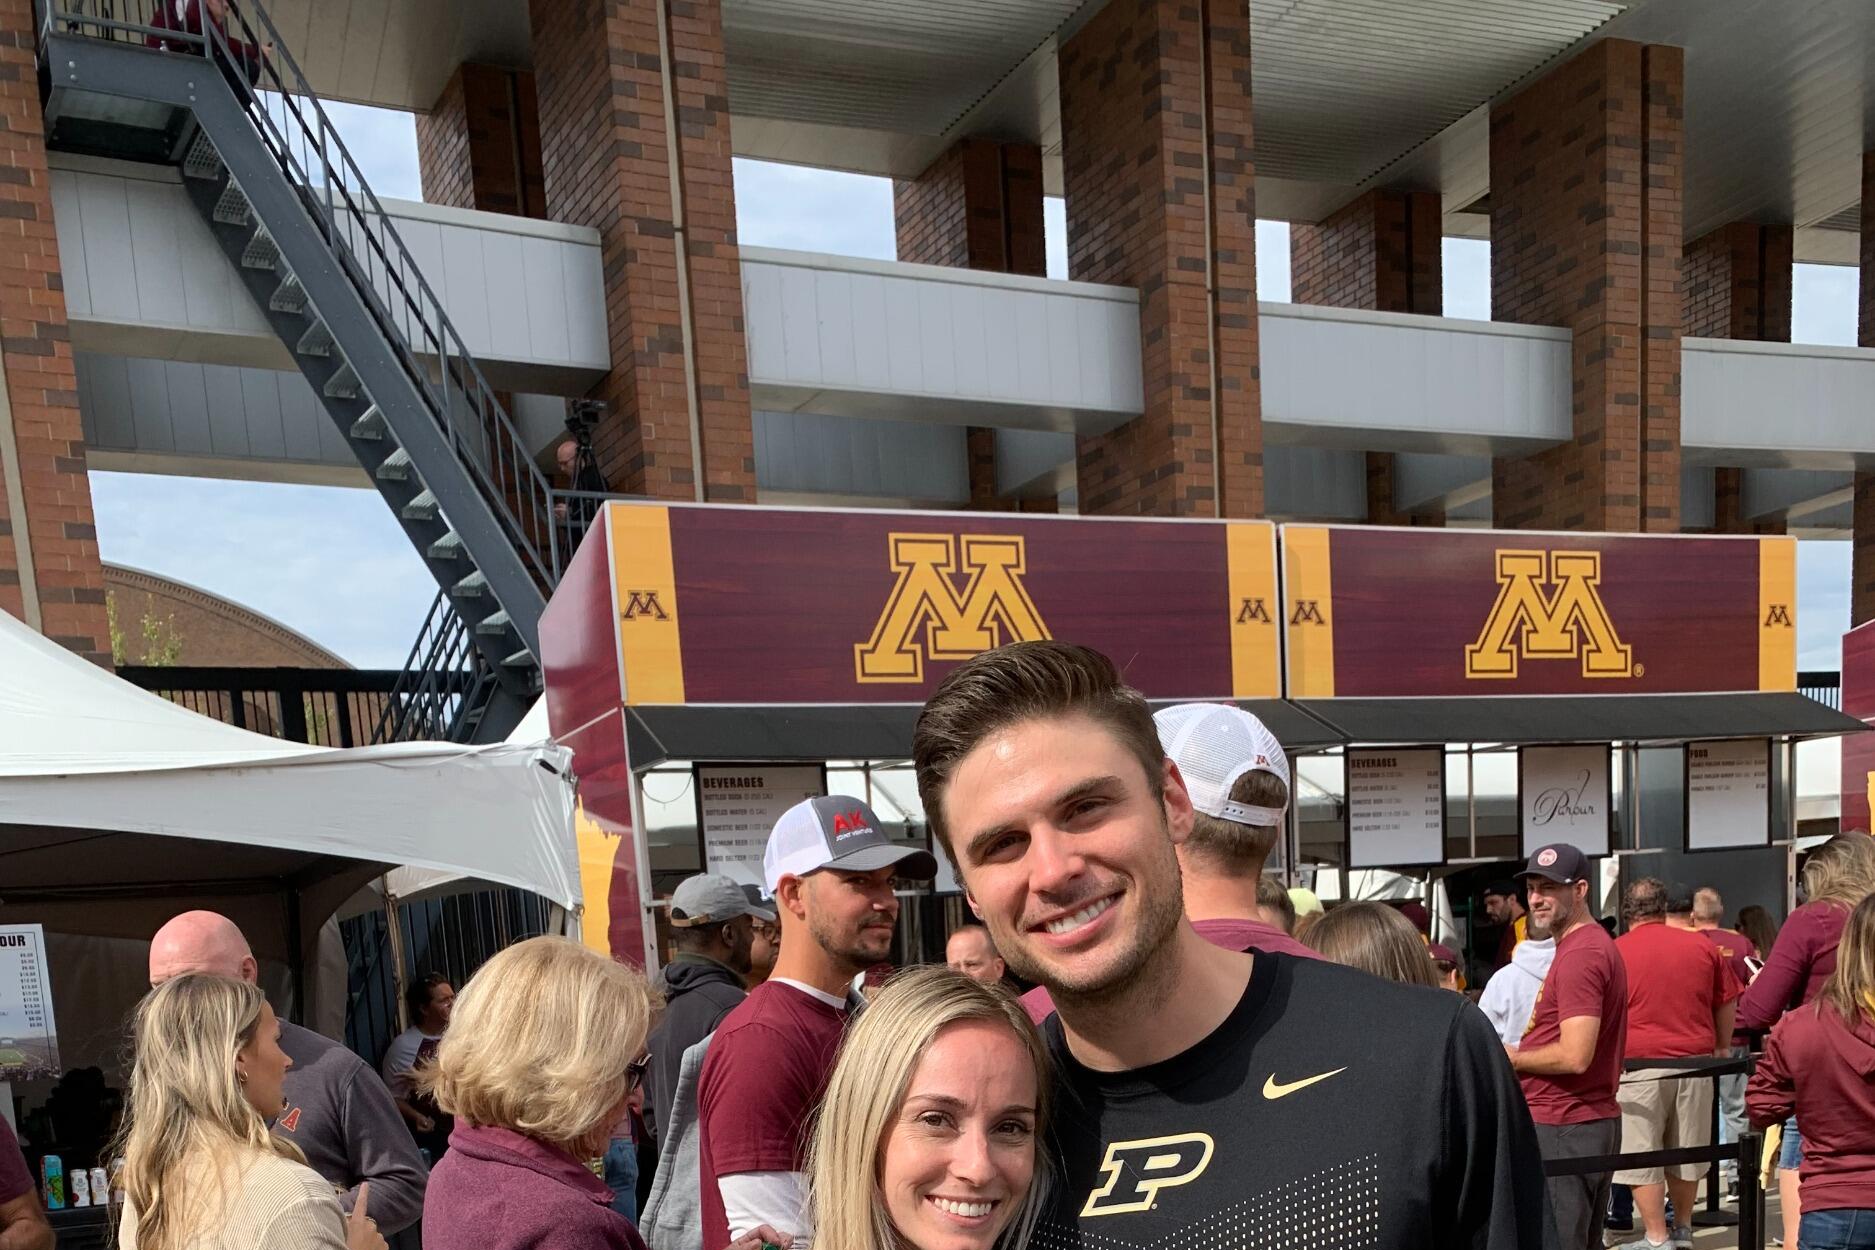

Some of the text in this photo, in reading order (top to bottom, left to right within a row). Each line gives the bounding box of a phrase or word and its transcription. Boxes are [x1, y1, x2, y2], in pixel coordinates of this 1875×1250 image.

[622, 590, 670, 621] M
[854, 532, 1053, 683] M
[1237, 598, 1271, 624] M
[1290, 600, 1326, 626] M
[1465, 549, 1632, 679] M
[1764, 604, 1793, 628] M
[1351, 757, 1397, 768] BEVERAGES
[703, 777, 764, 788] BEVERAGES
[1080, 1132, 1214, 1217] P
